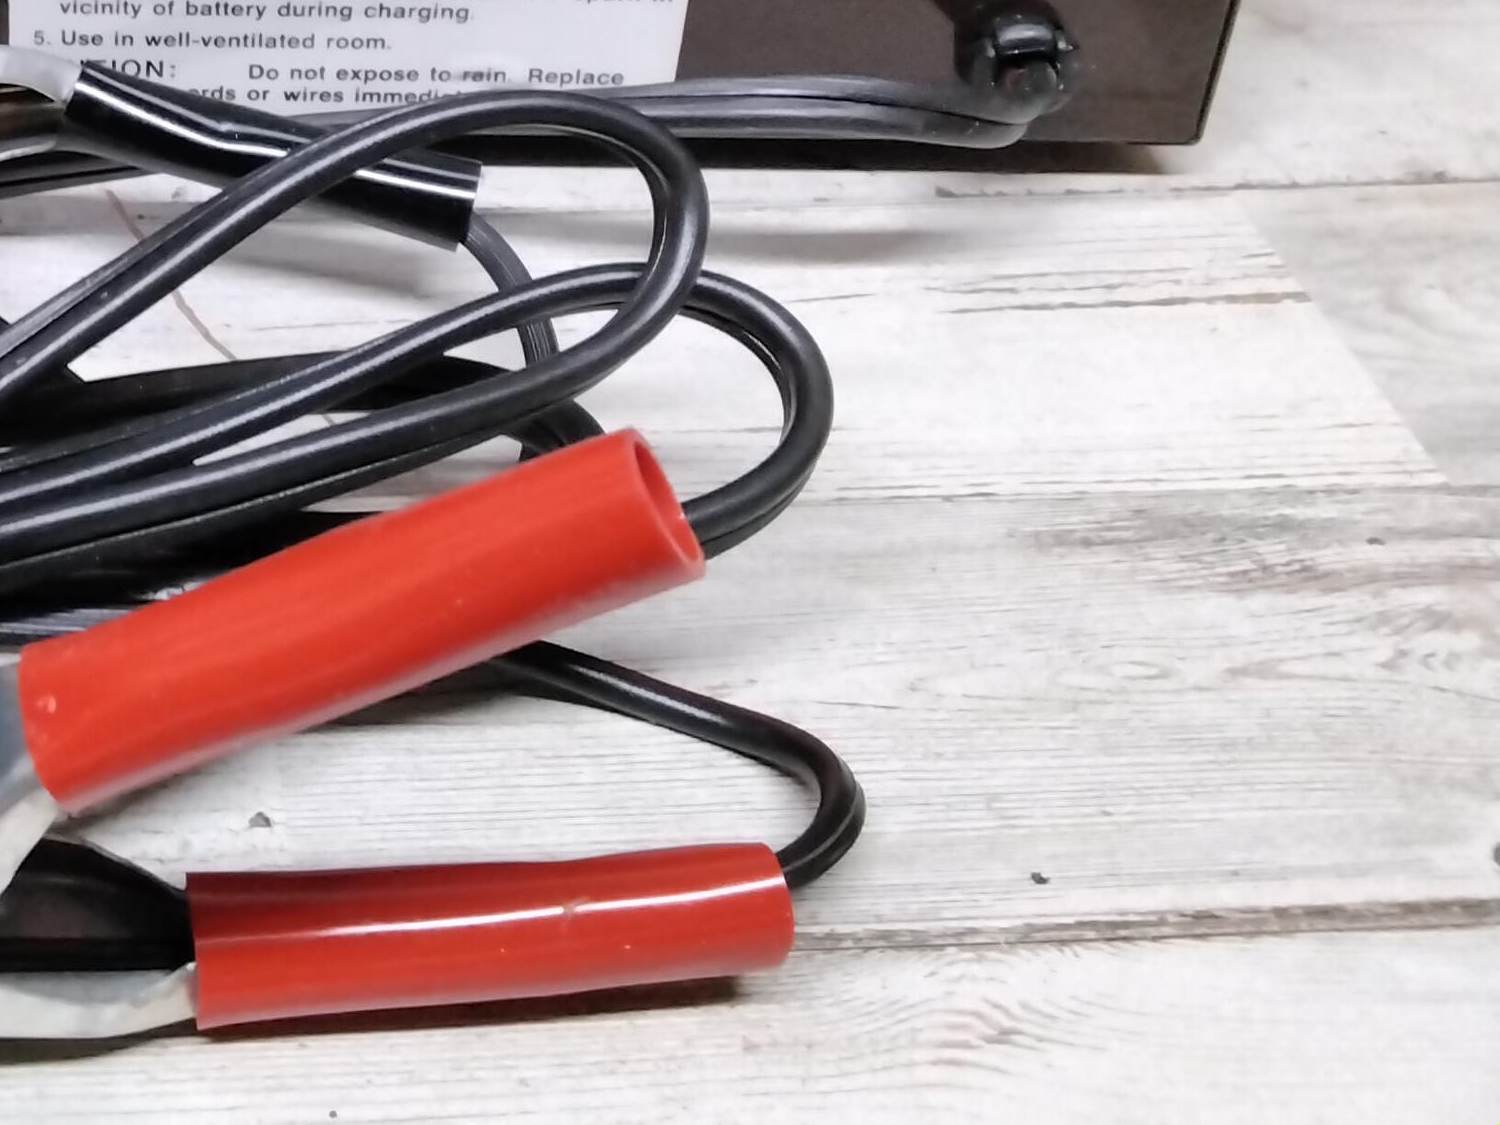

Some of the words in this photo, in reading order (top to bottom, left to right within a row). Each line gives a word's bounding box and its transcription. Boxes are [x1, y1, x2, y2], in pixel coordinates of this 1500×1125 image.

[60, 0, 141, 18] vicinity
[153, 0, 175, 16] of
[186, 0, 266, 20] battery
[278, 2, 352, 21] during
[364, 4, 474, 24] charging.
[33, 31, 51, 46] 5.
[61, 31, 103, 47] Use
[115, 31, 134, 47] in
[145, 31, 314, 49] well-ventilated
[327, 36, 391, 50] room.
[249, 65, 279, 80] Do
[290, 66, 326, 81] not
[336, 67, 419, 85] expose
[431, 68, 450, 82] to
[528, 68, 624, 85] Replace
[247, 88, 269, 101] or
[284, 87, 344, 102] wires
